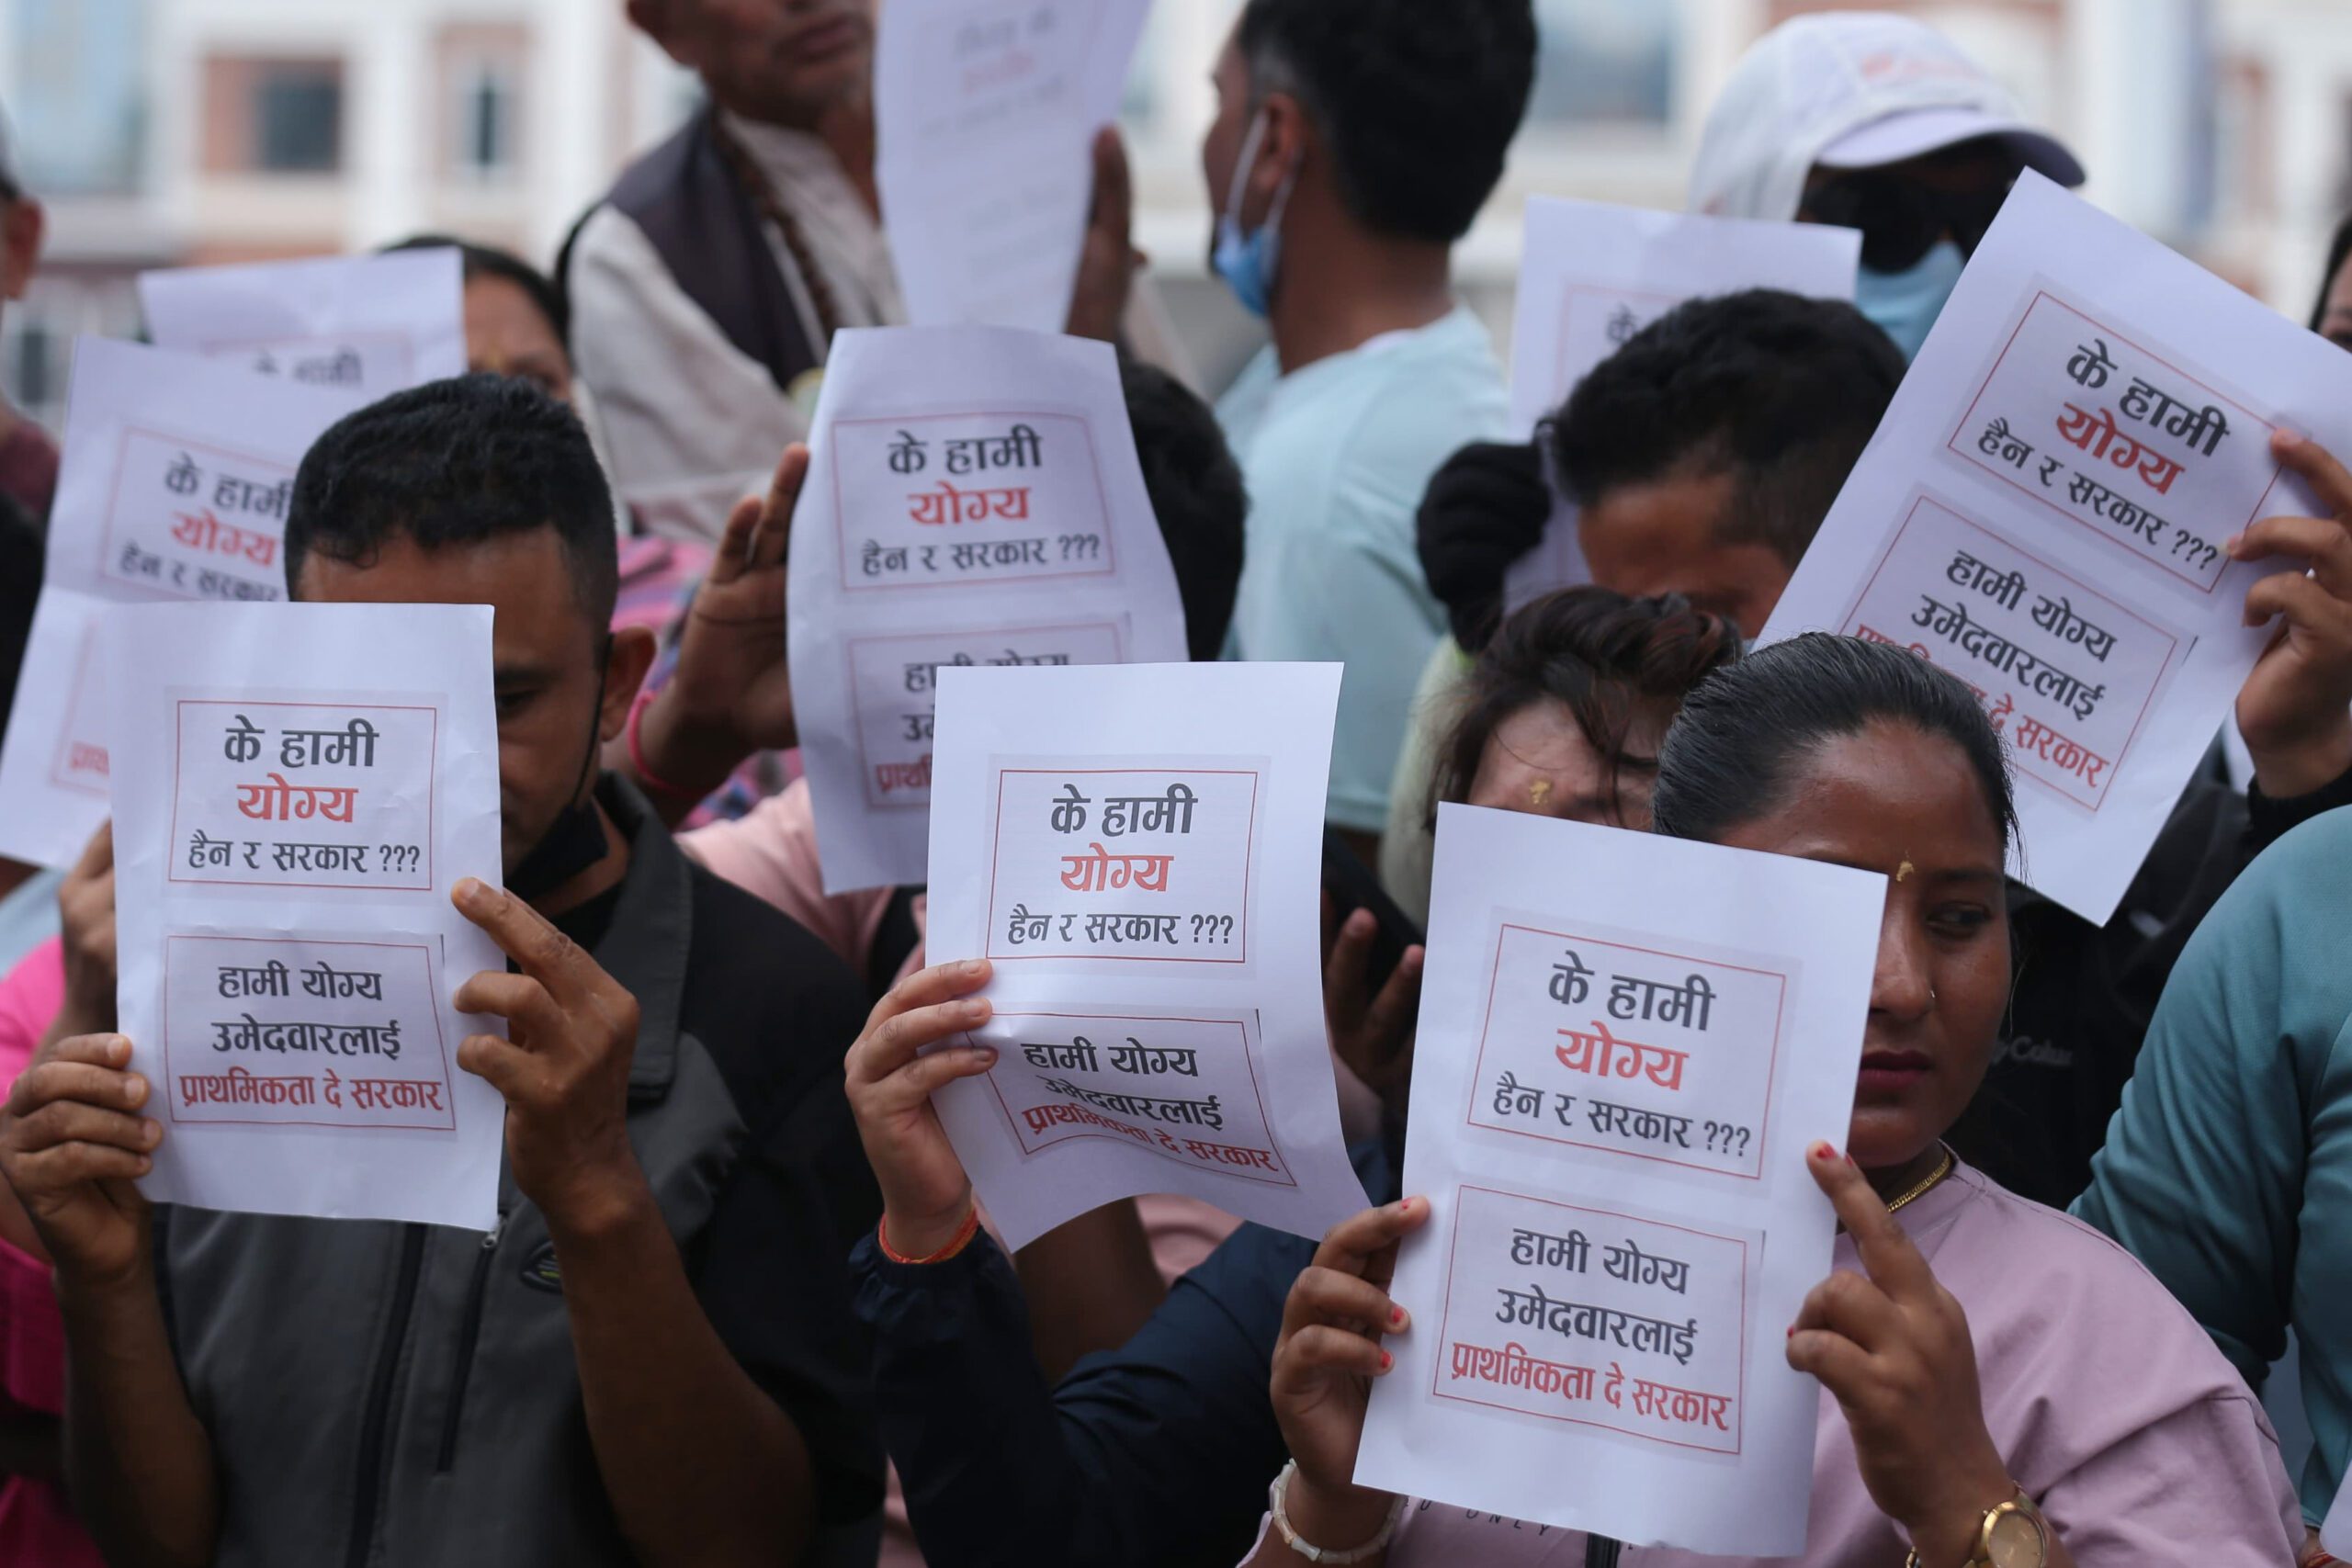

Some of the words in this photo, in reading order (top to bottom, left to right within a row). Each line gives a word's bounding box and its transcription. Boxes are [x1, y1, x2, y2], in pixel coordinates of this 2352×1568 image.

[2066, 338, 2118, 389] के
[2120, 378, 2230, 457] हामी
[165, 451, 204, 494] के
[888, 430, 928, 475] के
[944, 424, 1042, 474] हामी
[2056, 400, 2187, 495] योग्य
[908, 481, 1031, 525] योग्य
[1978, 417, 2035, 468] हैन
[2037, 456, 2064, 487] र
[2068, 471, 2170, 547] सरकार
[2175, 529, 2219, 570] ???
[169, 507, 278, 567] योग्य
[862, 539, 909, 577] हैन
[919, 545, 939, 571] र
[949, 538, 1048, 570] सरकार
[1057, 534, 1100, 560] ???
[172, 558, 187, 586] र
[1946, 550, 2028, 611] हामी
[2030, 596, 2118, 663] योग्य
[1911, 594, 2107, 722] उमेदवारलाई
[224, 714, 265, 762] के
[279, 717, 379, 768] हामी
[2016, 715, 2110, 788] सरकार
[236, 773, 358, 823] योग्य
[1051, 784, 1091, 834] के
[1102, 783, 1198, 837] हामी
[188, 829, 233, 868] हैन
[243, 842, 261, 868] र
[272, 843, 369, 873] सरकार
[379, 845, 420, 873] ???
[1060, 842, 1174, 892] योग्य
[1008, 904, 1052, 944] हैन
[1058, 914, 1078, 942] र
[1084, 914, 1181, 944] सरकार
[1190, 914, 1234, 944] ???
[218, 960, 289, 998] हामी
[301, 962, 381, 1000] योग्य
[1549, 951, 1594, 1006] के
[1607, 974, 1715, 1032] हामी
[210, 1014, 401, 1060] उमेदवारलाई
[1021, 1036, 1100, 1072] हामी
[1107, 1038, 1198, 1077] योग्य
[1555, 1021, 1689, 1091] योग्य
[178, 1066, 314, 1108] प्राथमिकता
[323, 1068, 342, 1109] दे
[349, 1079, 445, 1111] सरकार
[1036, 1076, 1223, 1131] उमेदवारलाई
[1493, 1071, 1544, 1118] हैन
[1555, 1093, 1576, 1126] र
[1587, 1100, 1693, 1148] सरकार
[1703, 1121, 1750, 1156] ???
[1154, 1128, 1182, 1154] दे
[1182, 1139, 1278, 1171] सरकार
[1510, 1228, 1590, 1274] हामी
[1603, 1238, 1689, 1295] योग्य
[1496, 1283, 1698, 1366] उमेदवारलाई
[1451, 1341, 1596, 1402] प्राथमिकता
[1605, 1361, 1624, 1410] दे
[1632, 1377, 1732, 1432] सरकार
